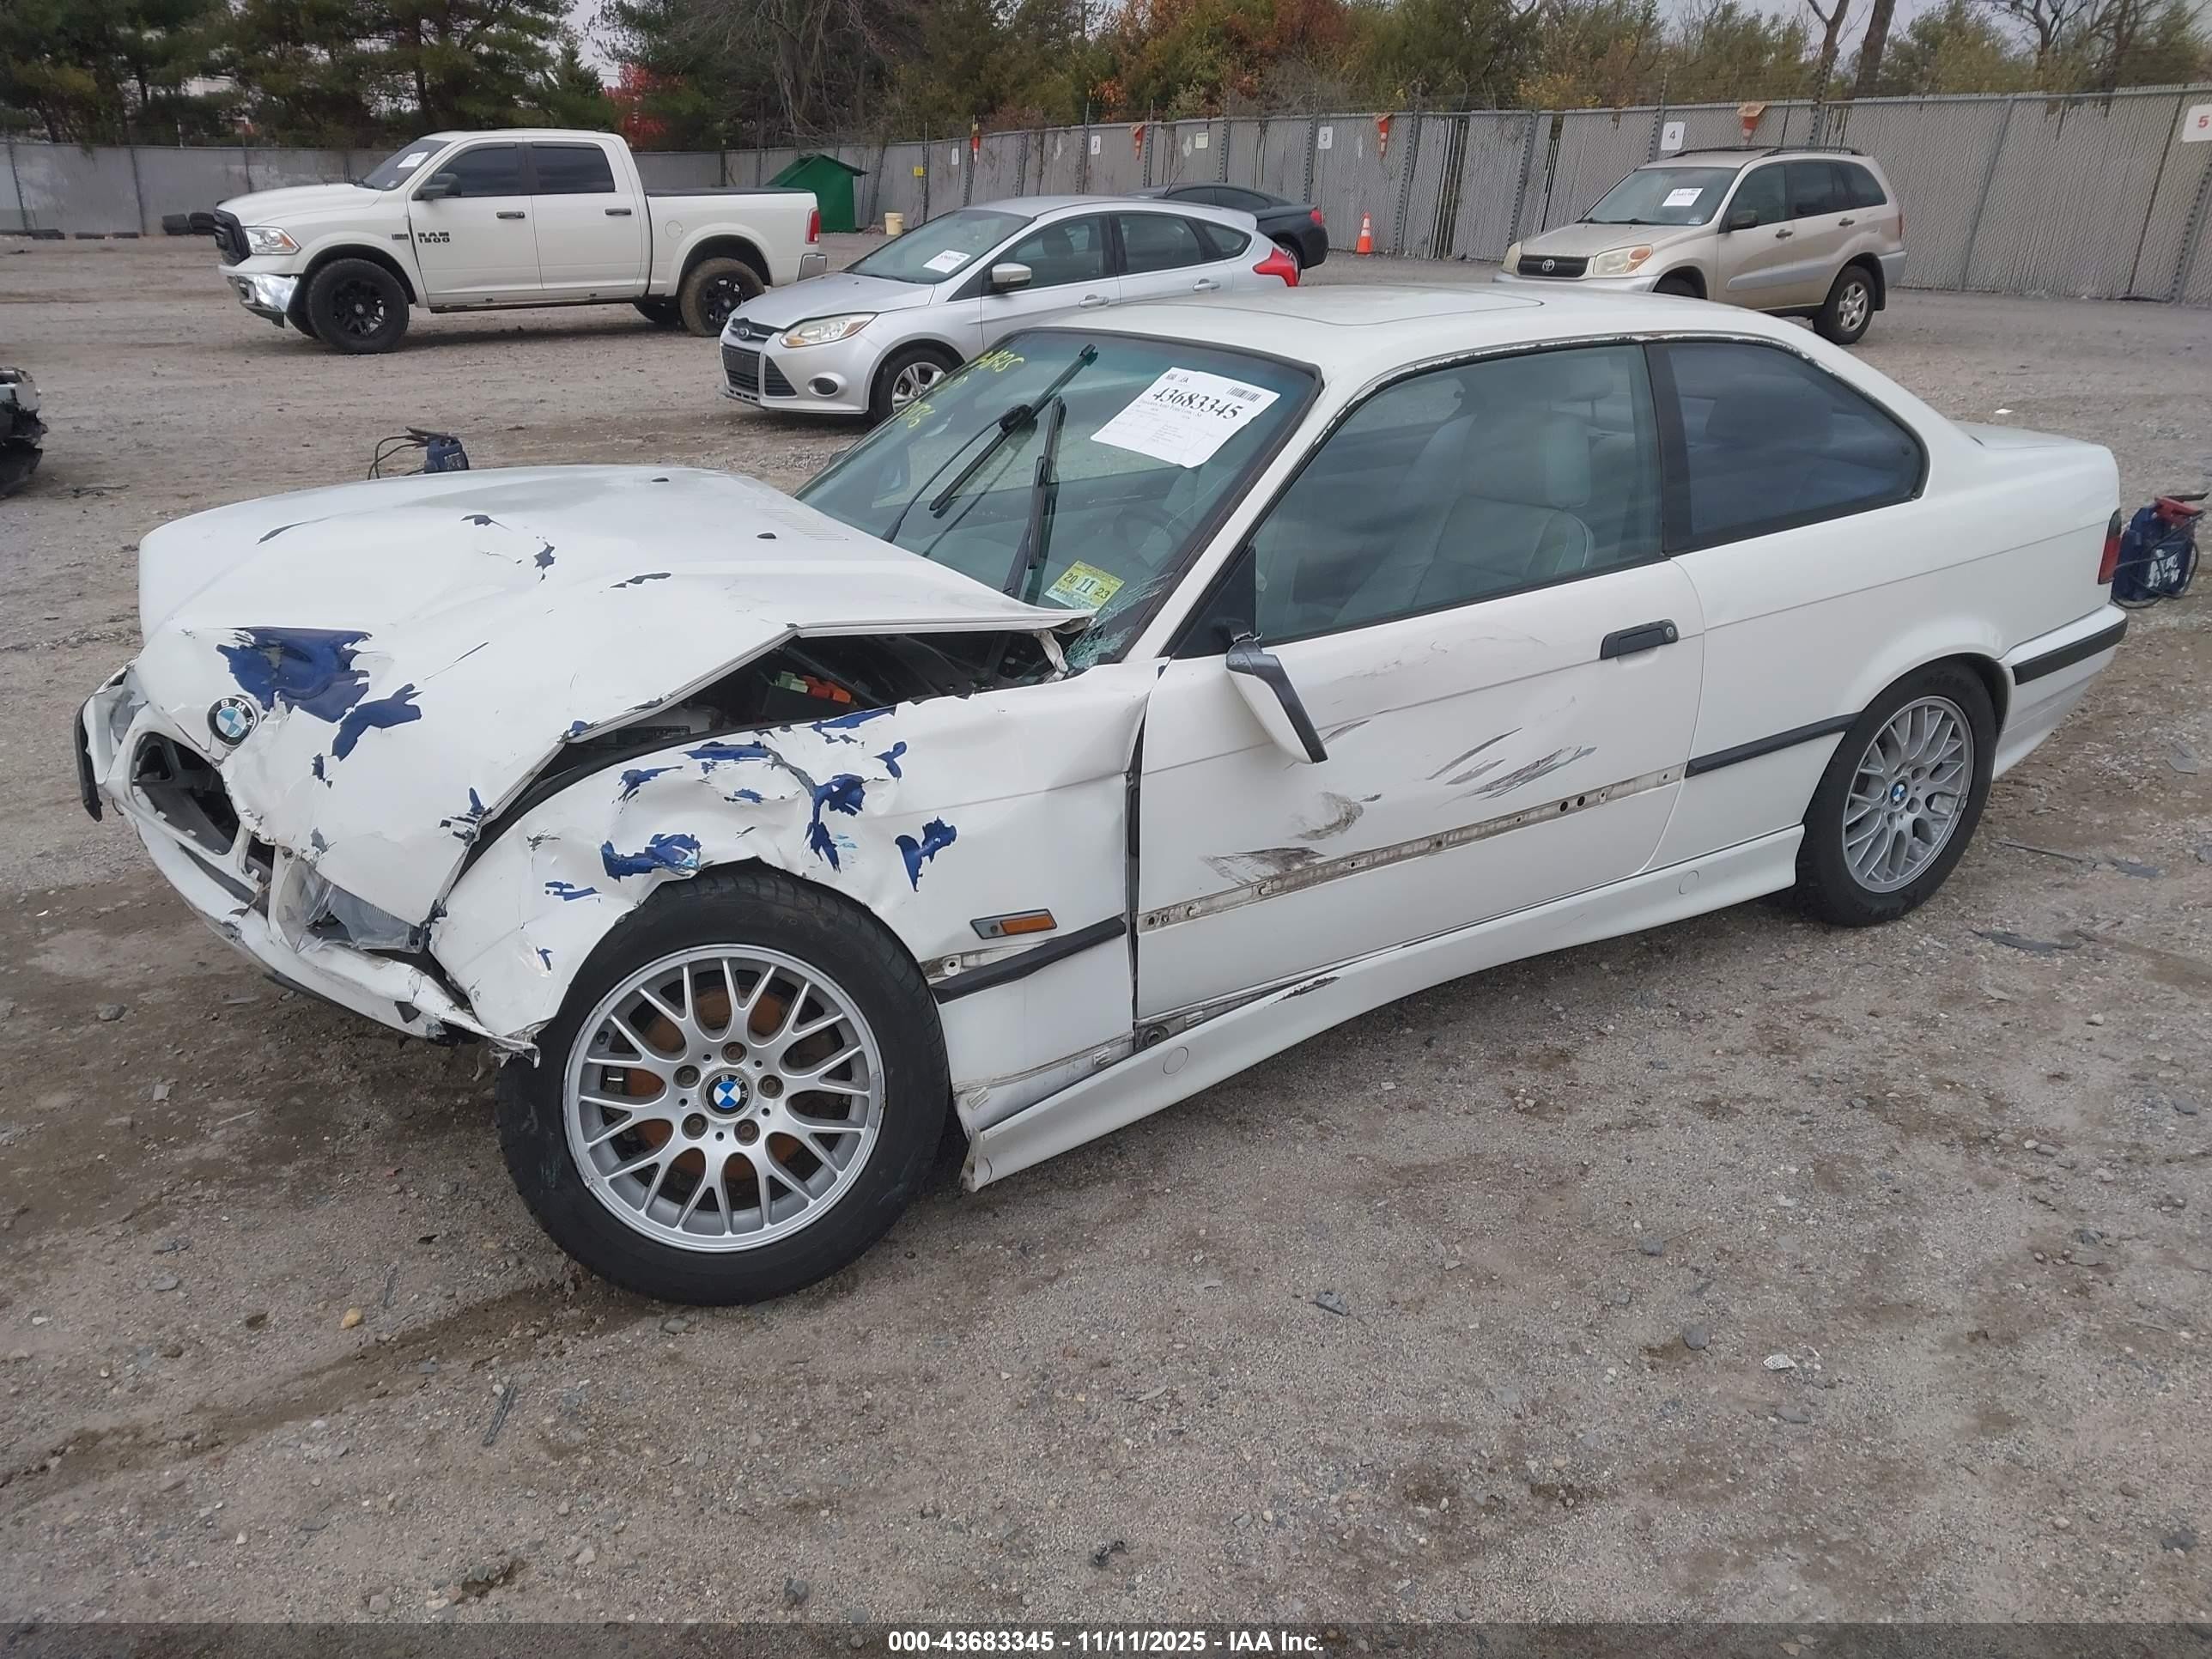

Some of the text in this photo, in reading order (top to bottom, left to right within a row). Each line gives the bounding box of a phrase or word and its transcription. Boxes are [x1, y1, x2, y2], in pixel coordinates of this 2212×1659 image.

[2197, 115, 2210, 129] 5
[1322, 133, 1328, 142] 3
[1668, 131, 1677, 139] 4
[1152, 386, 1243, 420] 43683345
[1064, 572, 1079, 585] 20
[1075, 577, 1096, 594] 11
[1094, 586, 1110, 599] 23
[220, 698, 254, 726] BMW
[720, 1074, 749, 1099] BMW
